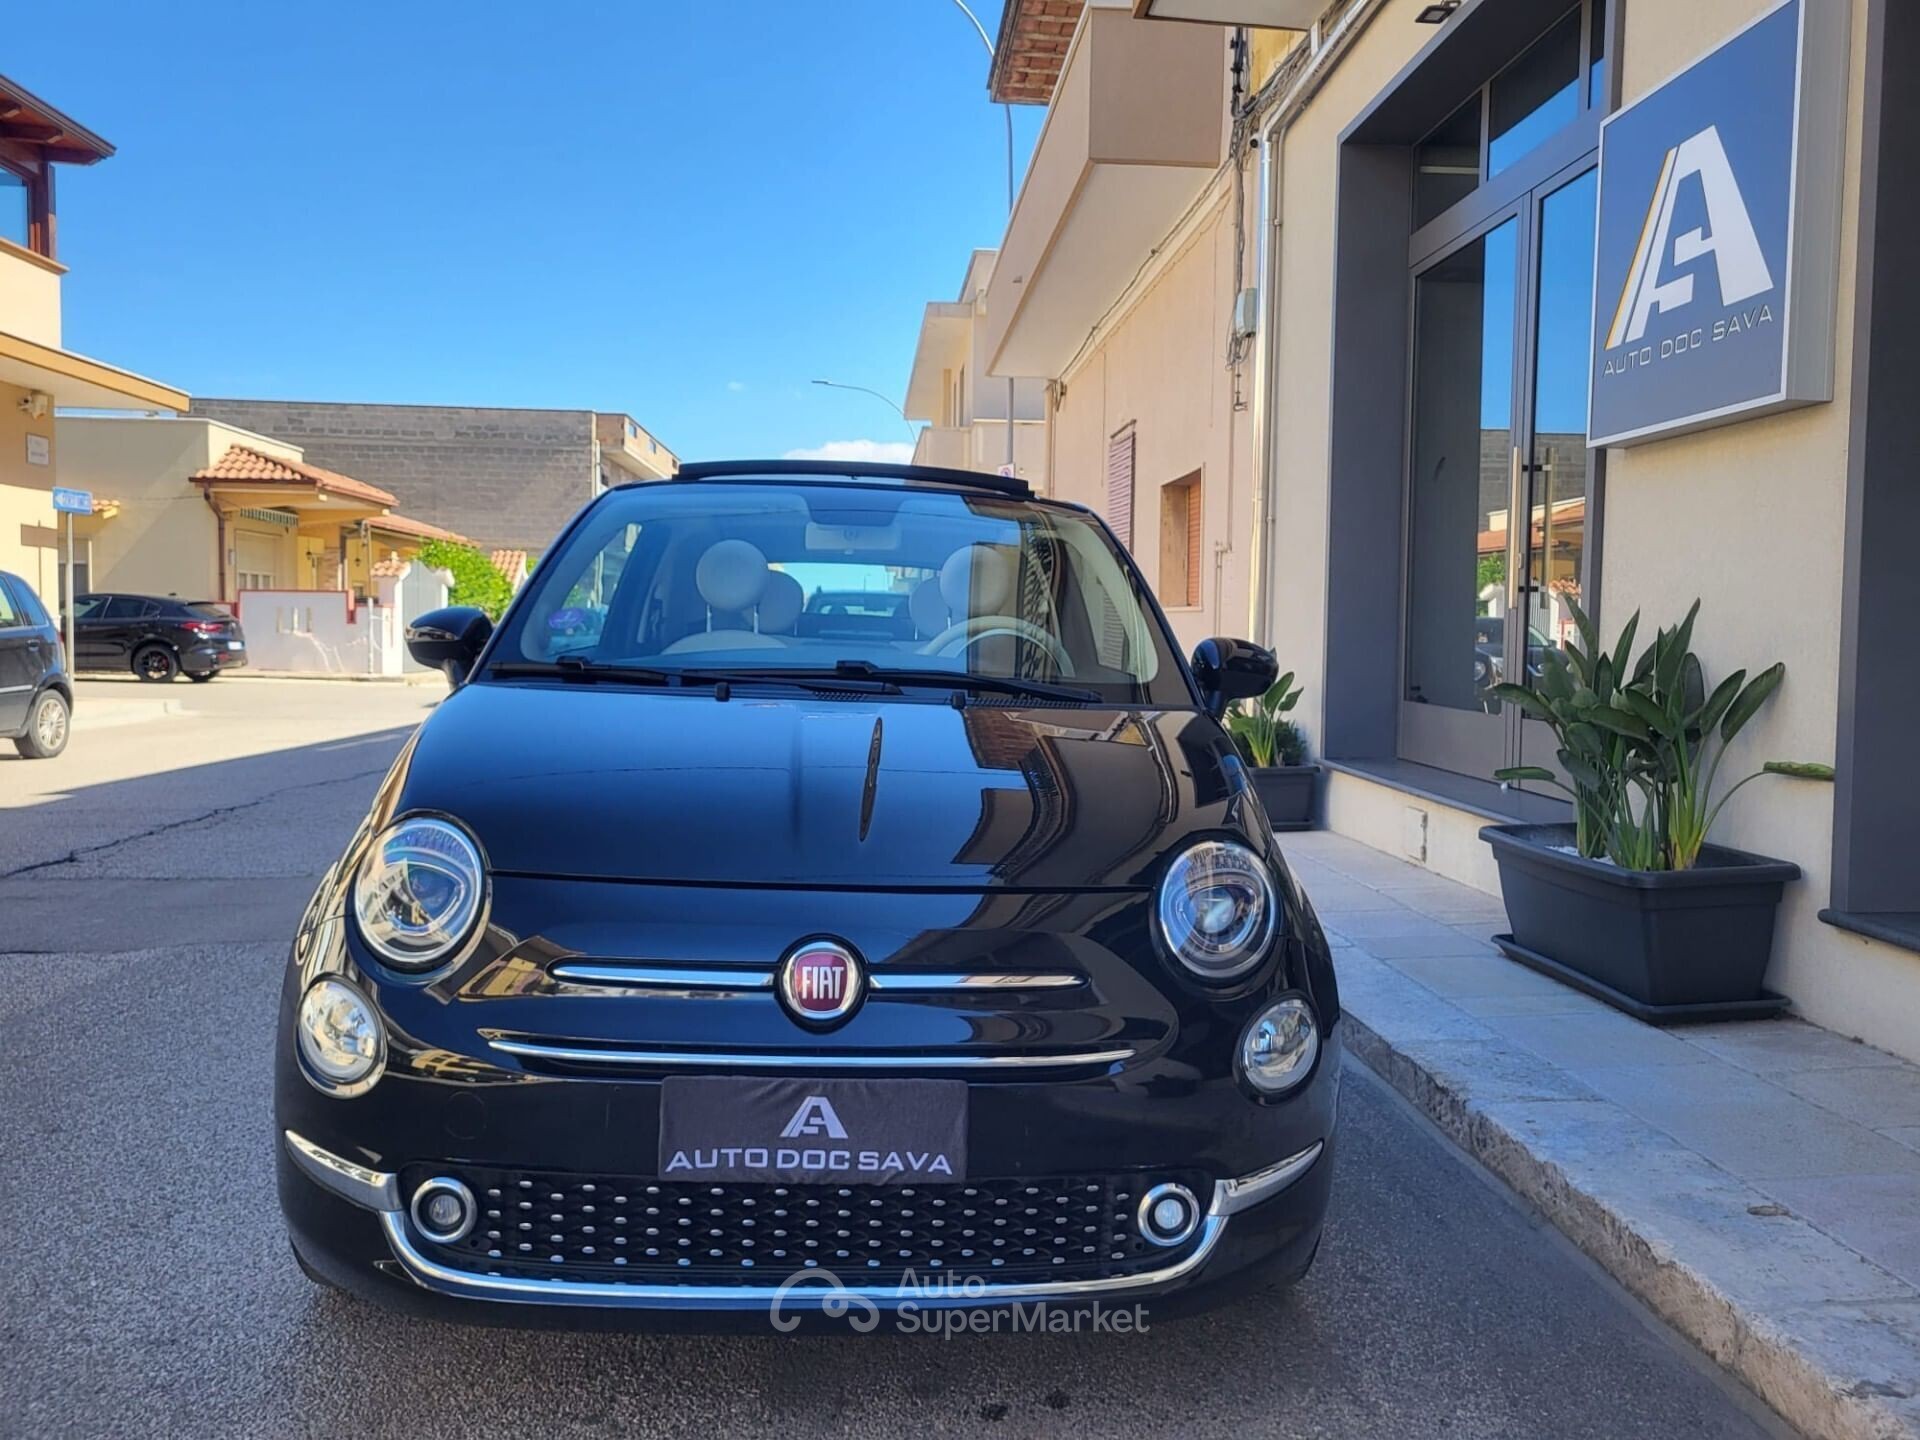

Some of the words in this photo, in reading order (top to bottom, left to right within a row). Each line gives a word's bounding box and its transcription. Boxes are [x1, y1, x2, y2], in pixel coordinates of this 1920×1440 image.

[1603, 346, 1652, 377] AUTO
[1660, 327, 1703, 359] DOC
[1711, 304, 1774, 342] SAVA
[801, 966, 845, 1000] FIAT
[665, 1148, 769, 1173] AUTO
[776, 1149, 851, 1170] DOC
[857, 1151, 953, 1175] SAVA
